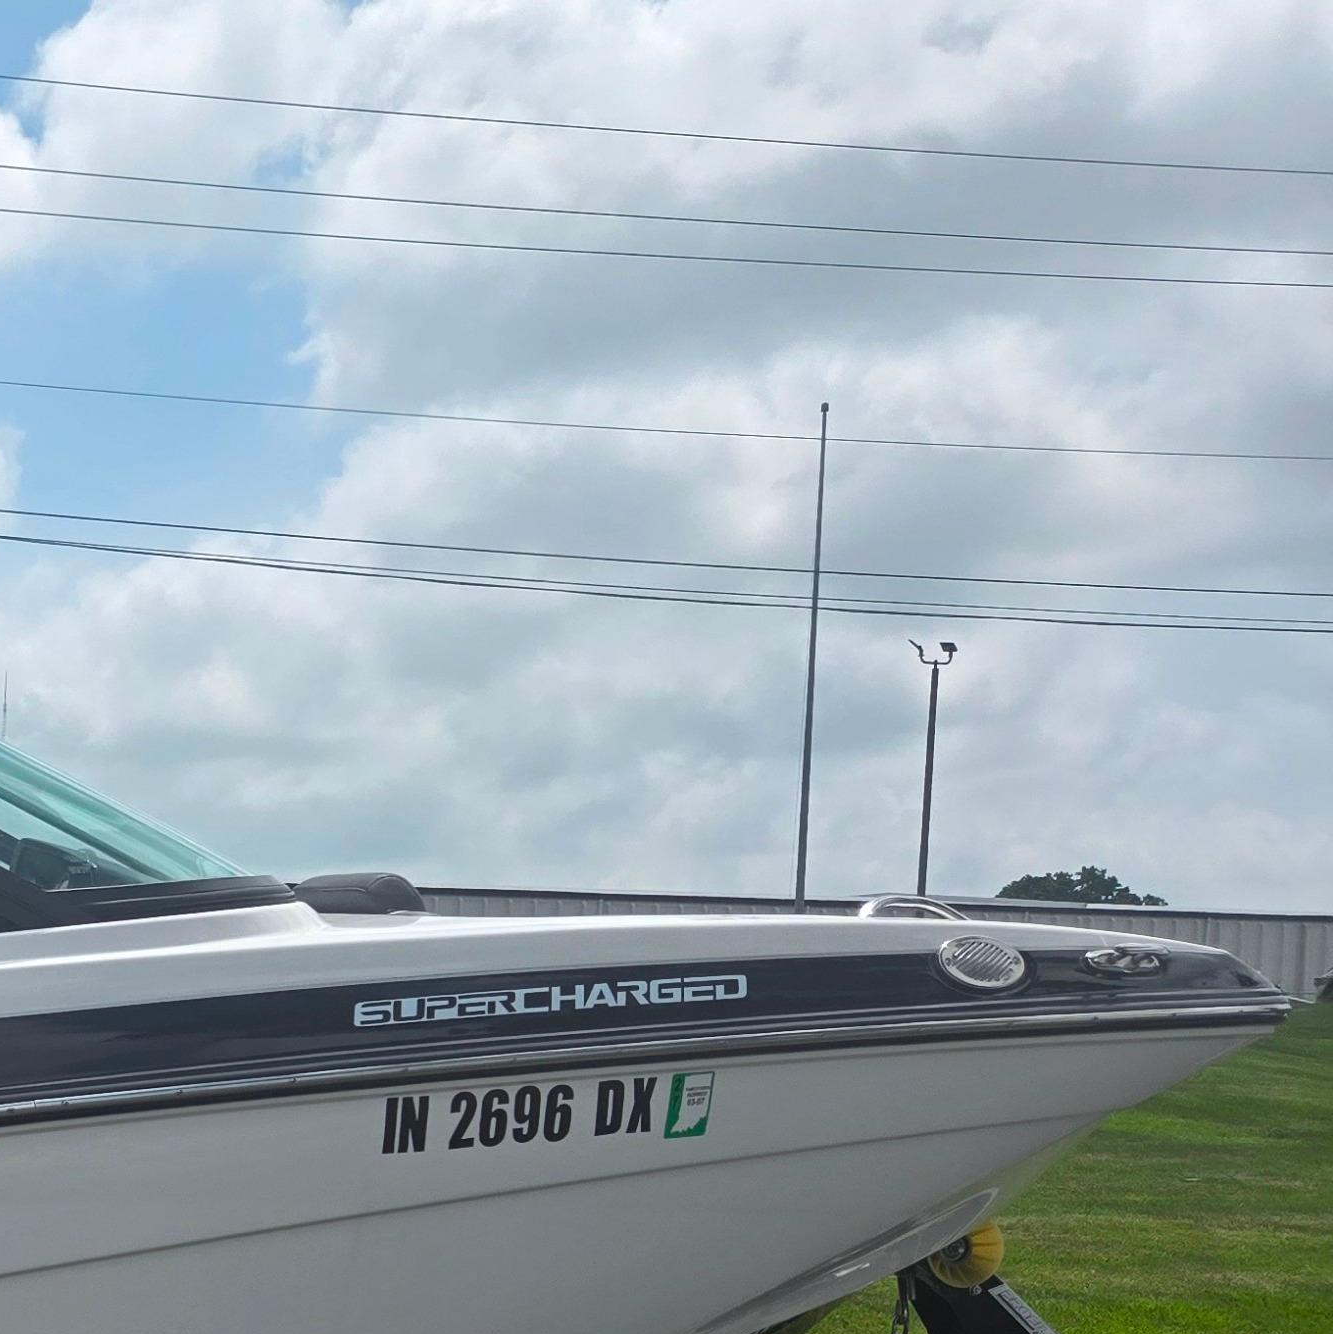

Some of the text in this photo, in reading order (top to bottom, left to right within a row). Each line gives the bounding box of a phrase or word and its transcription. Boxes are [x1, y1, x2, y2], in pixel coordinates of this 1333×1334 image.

[354, 974, 748, 1027] SUPERCHARGED
[381, 1076, 658, 1155] IN 2696 DX
